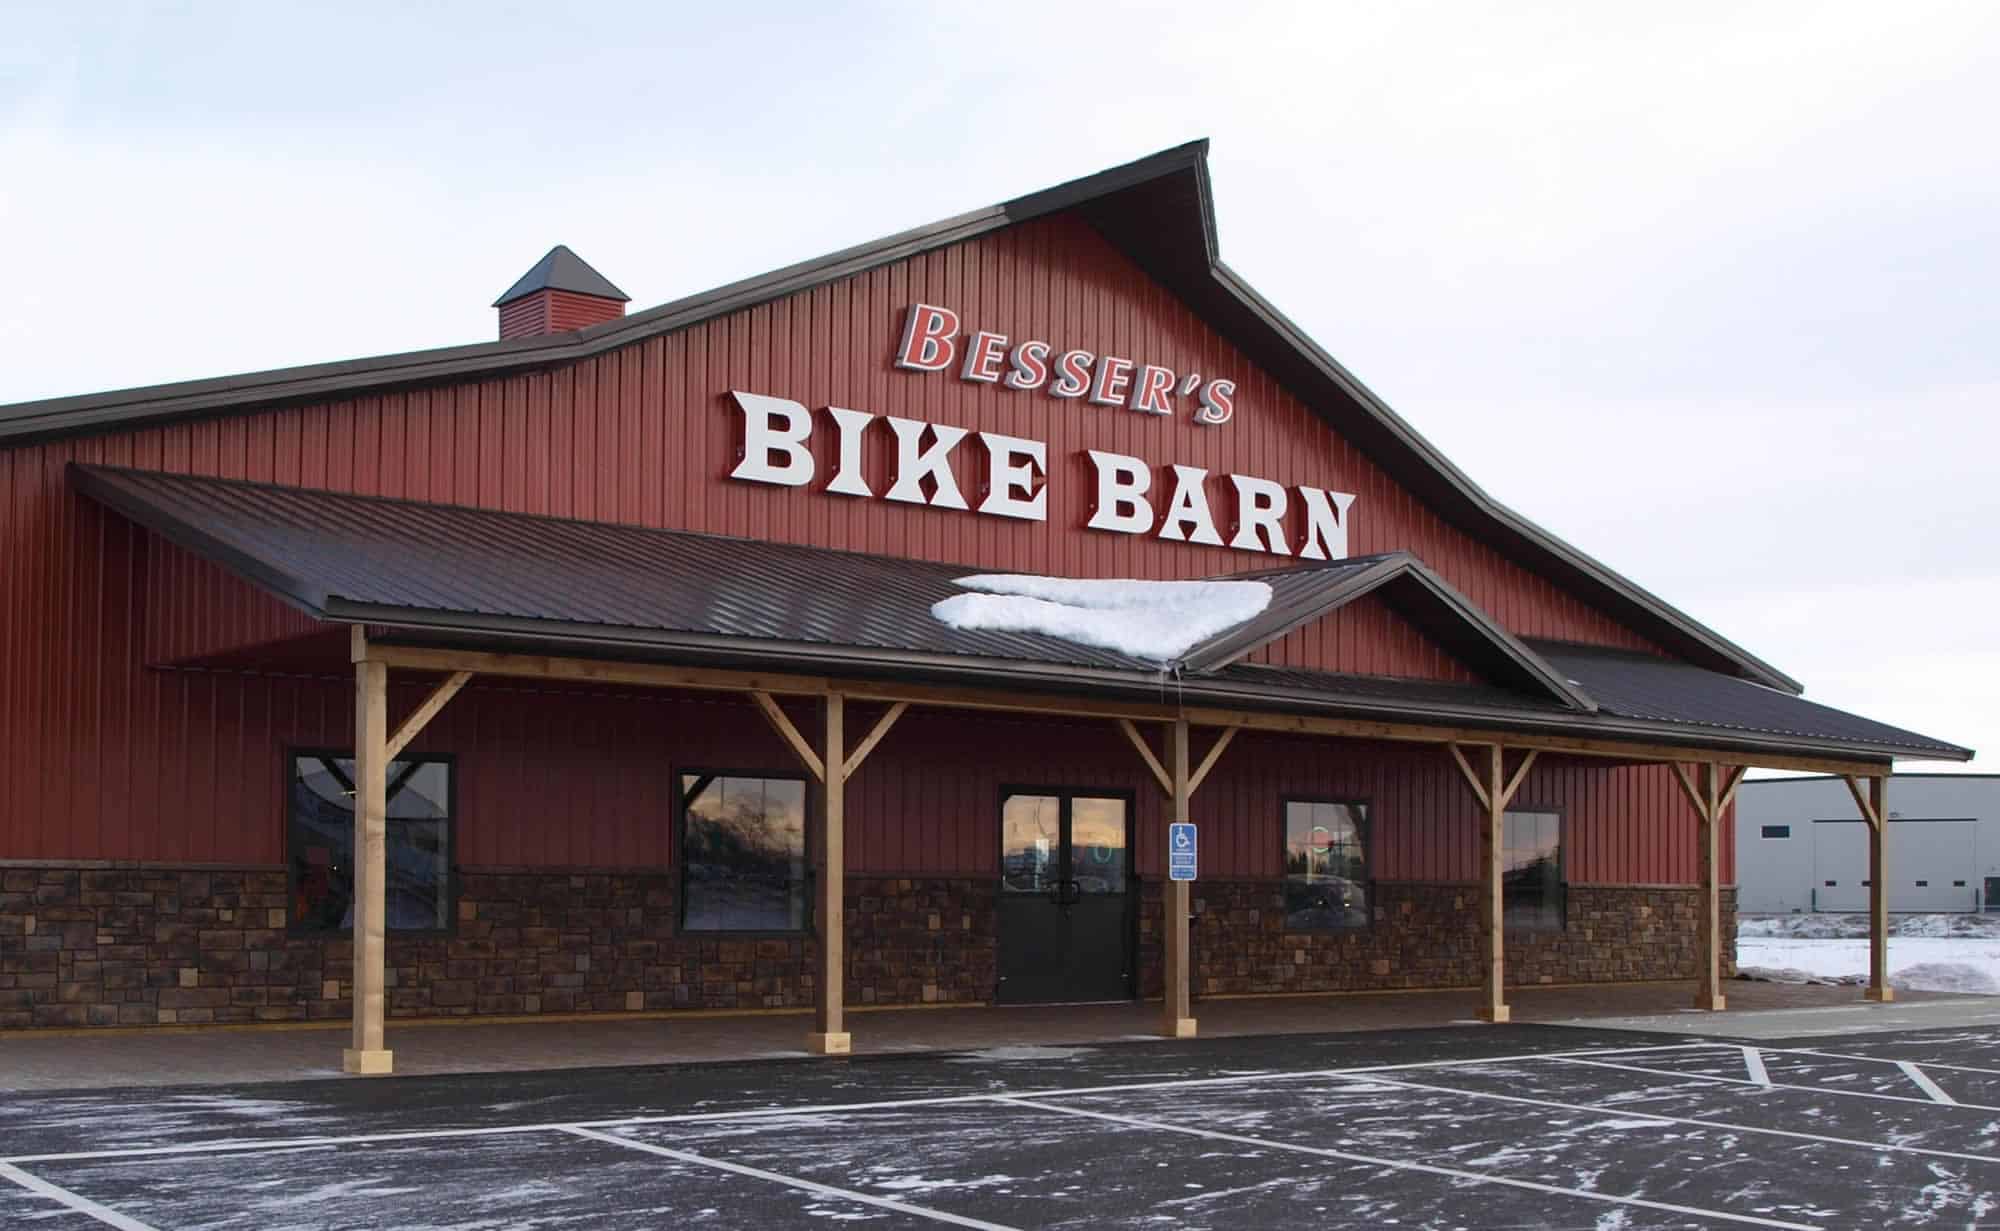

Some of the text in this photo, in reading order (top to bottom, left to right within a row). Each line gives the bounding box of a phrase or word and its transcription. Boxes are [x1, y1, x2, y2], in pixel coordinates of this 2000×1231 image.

[896, 302, 1236, 425] BESSER'S
[730, 390, 1356, 561] BIKE BARN
